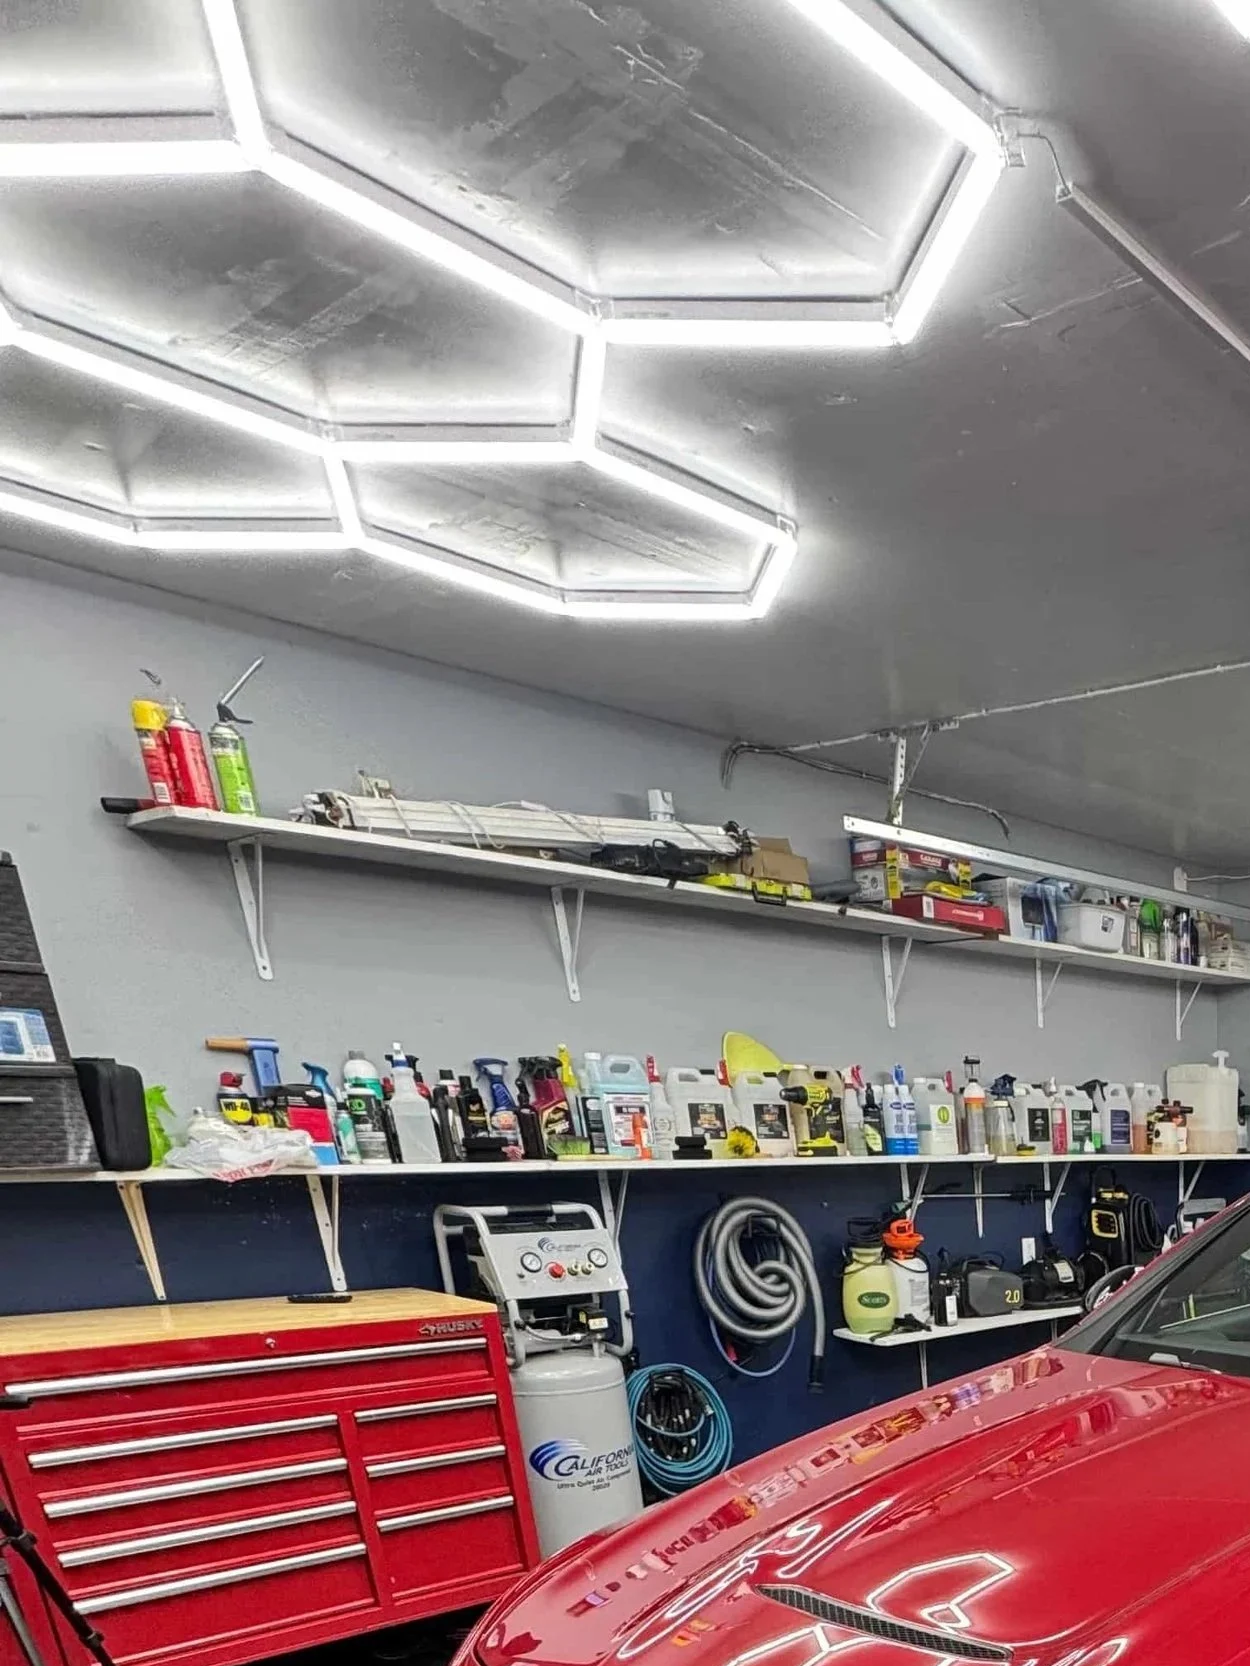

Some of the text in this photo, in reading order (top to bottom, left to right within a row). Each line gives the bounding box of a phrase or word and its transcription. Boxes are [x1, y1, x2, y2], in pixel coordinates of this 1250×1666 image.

[223, 1101, 250, 1111] WD-40
[1005, 1289, 1020, 1303] 2.0
[437, 1320, 484, 1334] HUSKY
[584, 1467, 603, 1477] AIR
[606, 1459, 629, 1472] TOOLS
